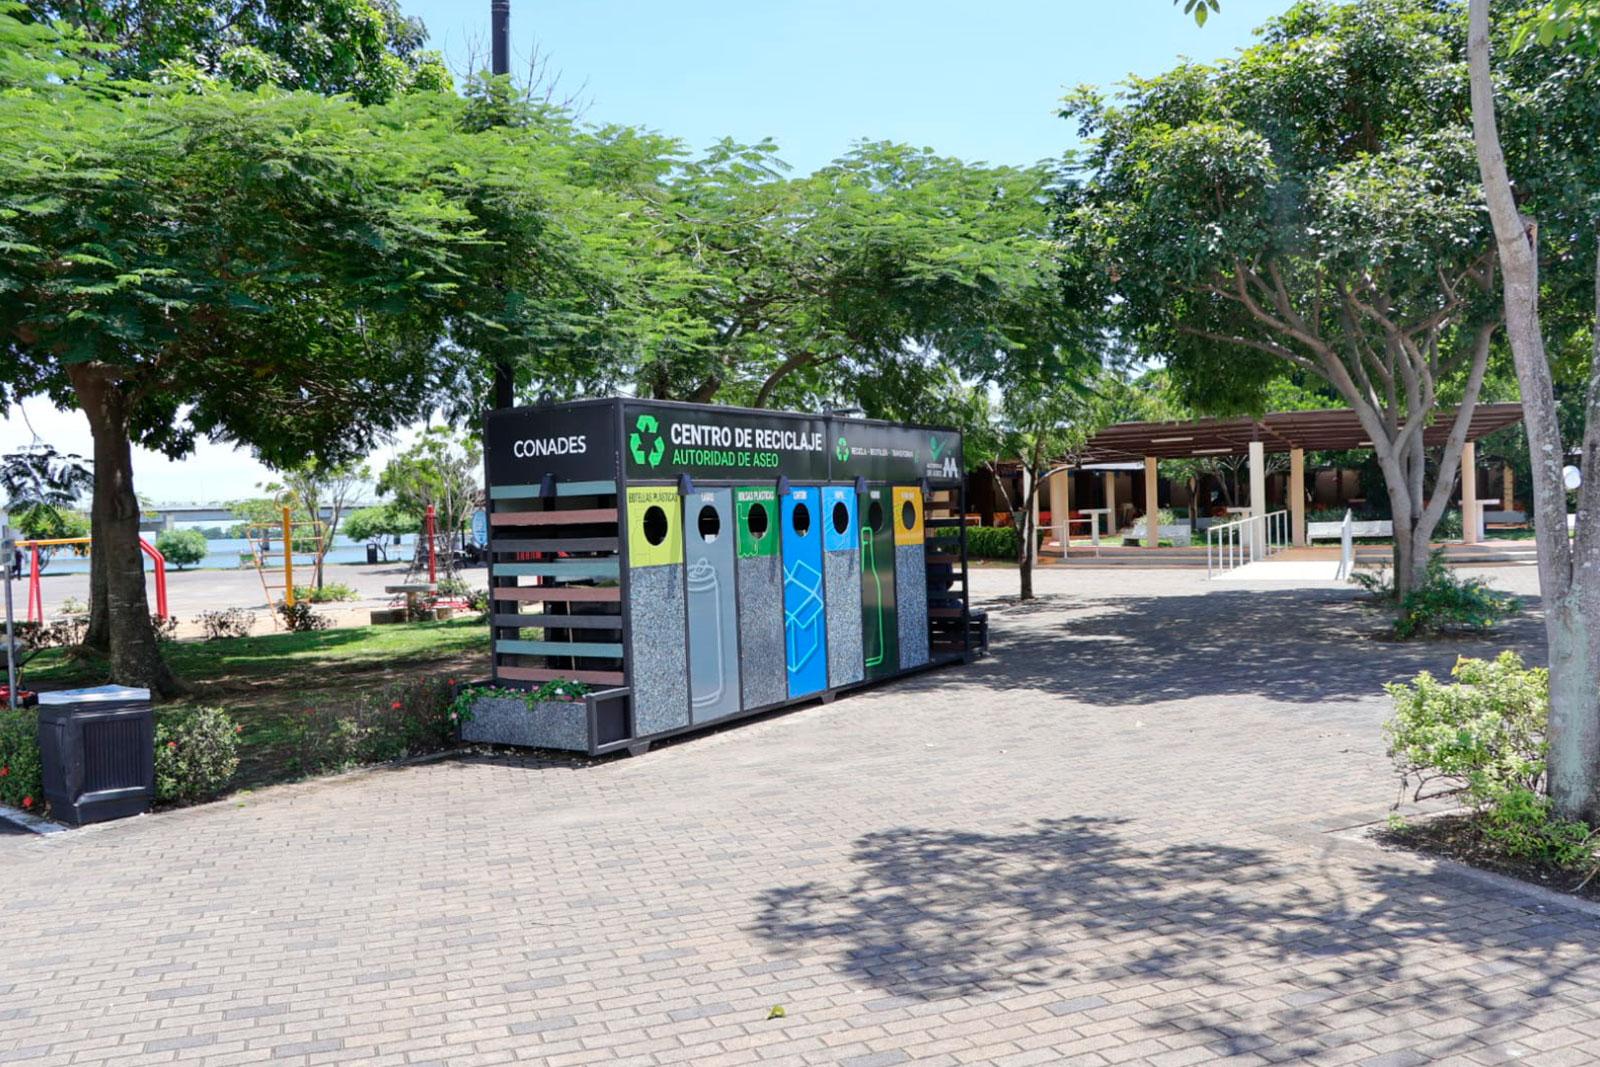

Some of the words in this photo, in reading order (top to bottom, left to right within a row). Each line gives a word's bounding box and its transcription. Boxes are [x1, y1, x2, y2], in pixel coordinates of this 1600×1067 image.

[513, 435, 587, 458] CONADES
[670, 423, 731, 447] CENTRO
[735, 428, 751, 448] DE
[755, 429, 823, 451] RECICLAJE
[672, 449, 735, 466] AUTORIDAD
[738, 451, 751, 467] DE
[753, 452, 779, 468] ASEO
